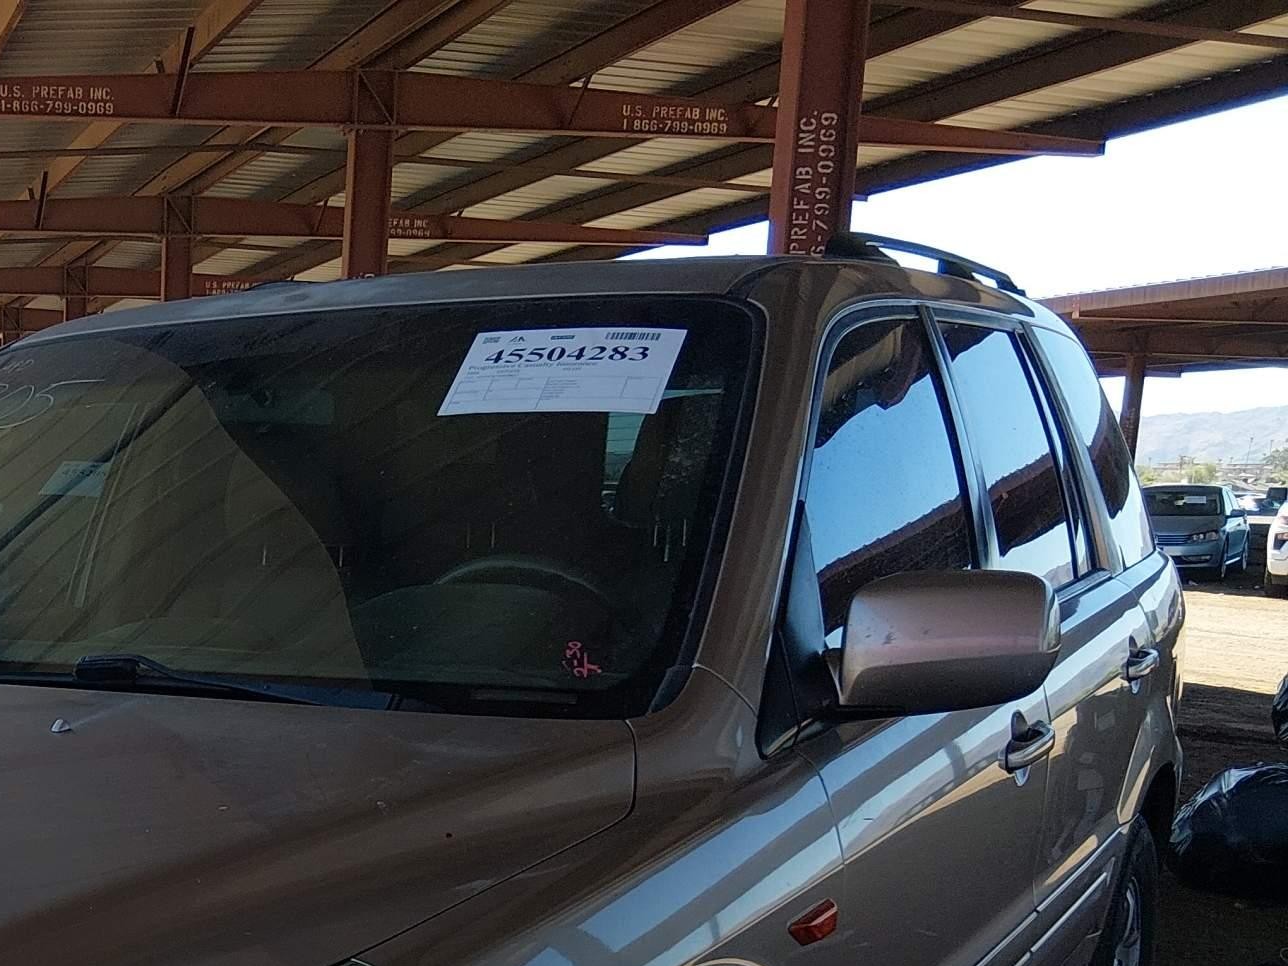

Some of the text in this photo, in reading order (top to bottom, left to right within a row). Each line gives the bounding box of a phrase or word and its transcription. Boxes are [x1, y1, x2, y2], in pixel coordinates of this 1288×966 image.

[0, 84, 114, 100] U.S. PREFAB INC.
[1, 99, 114, 114] 1-866-799-0969
[623, 104, 729, 121] U.S. PREFAB INC.
[789, 109, 818, 255] PREFAB INC.
[485, 345, 650, 364] 45504283
